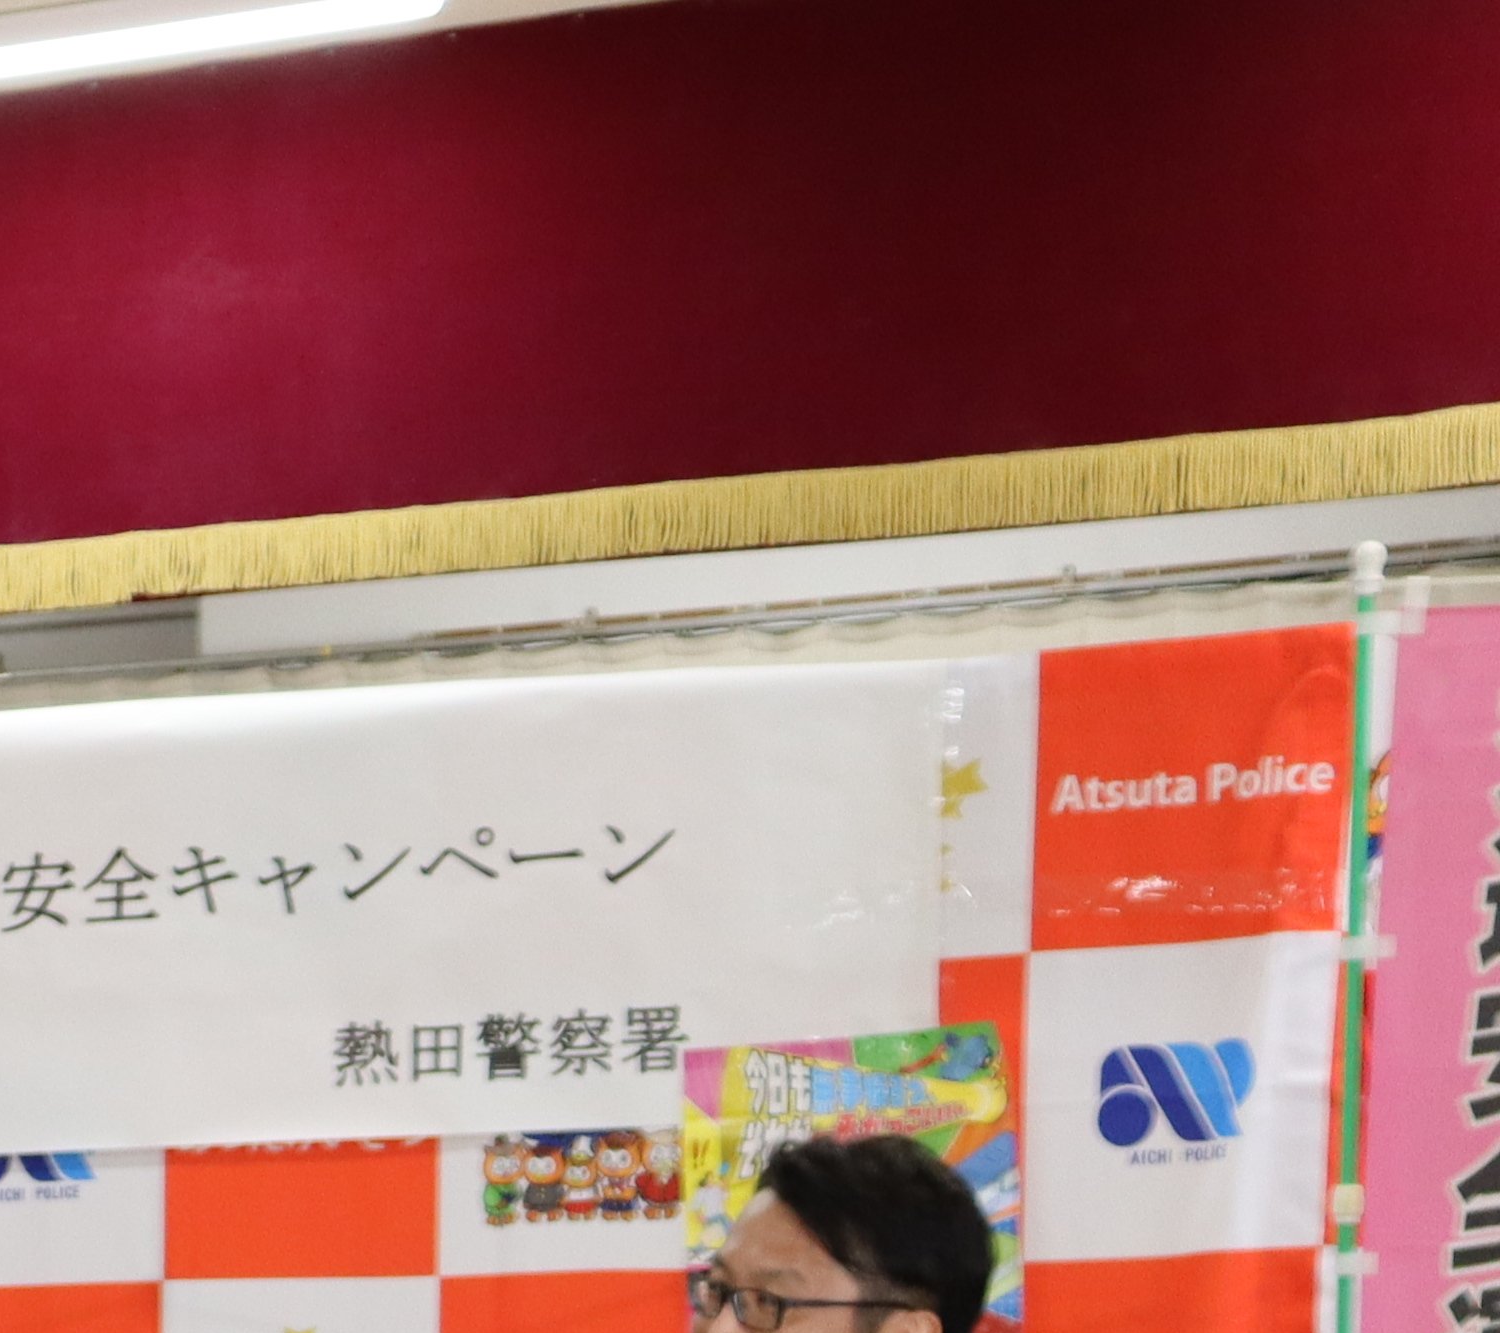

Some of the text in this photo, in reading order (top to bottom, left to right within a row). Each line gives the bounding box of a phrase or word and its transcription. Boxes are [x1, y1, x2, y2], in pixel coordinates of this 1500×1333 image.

[1052, 755, 1337, 815] Atsuta Police
[333, 1005, 690, 1087] 熱田警察署
